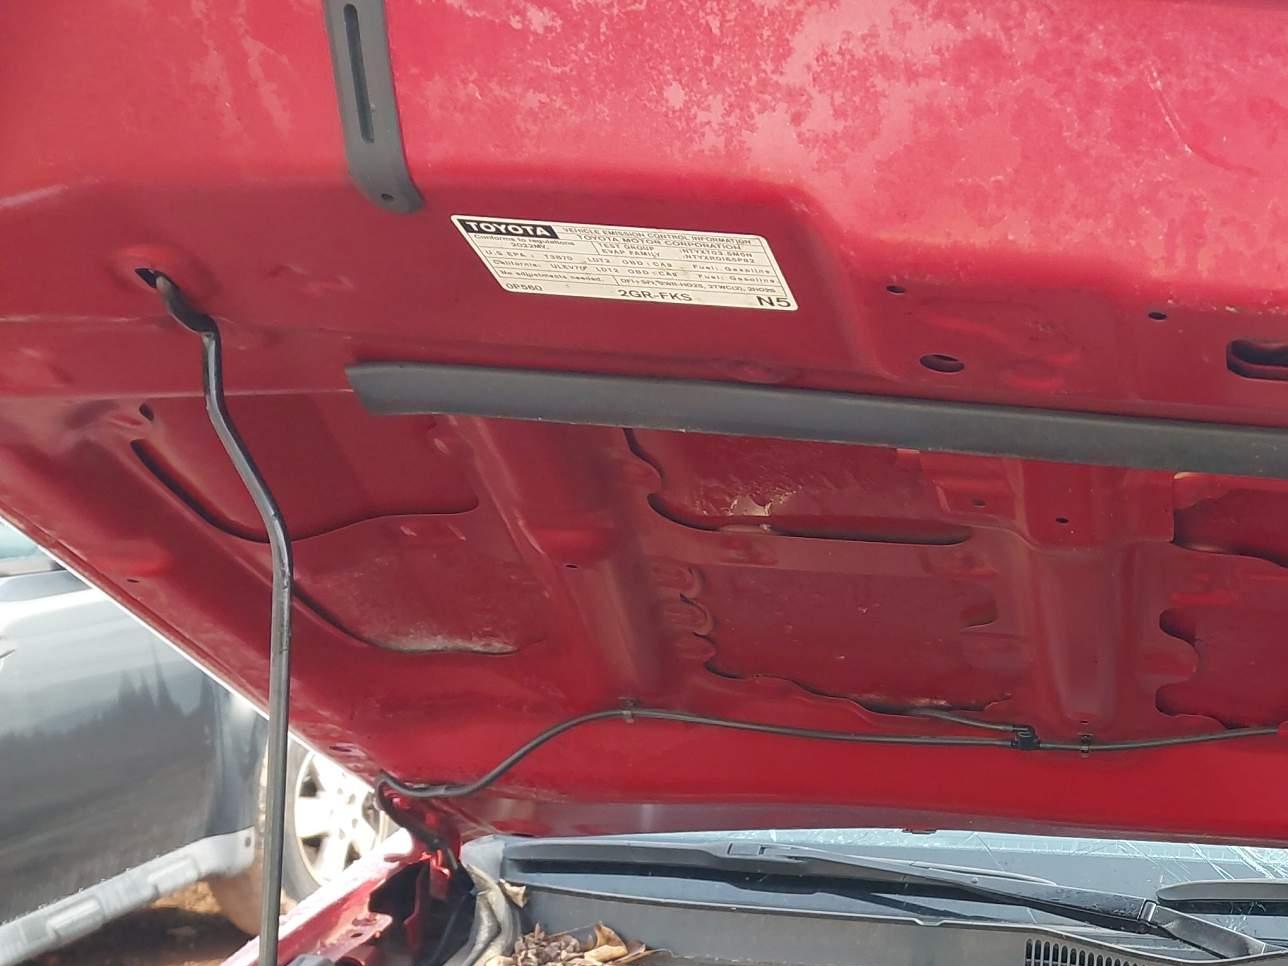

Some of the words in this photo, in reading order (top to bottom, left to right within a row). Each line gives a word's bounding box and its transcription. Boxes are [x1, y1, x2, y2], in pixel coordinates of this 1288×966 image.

[465, 221, 551, 236] TOYOTA
[602, 229, 645, 237] EMISSION
[647, 232, 690, 240] CONTROL
[691, 236, 751, 244] INFORMATION
[664, 240, 741, 250] CORPORATION
[617, 288, 693, 301] 2GR-FKS
[756, 295, 792, 307] N5
